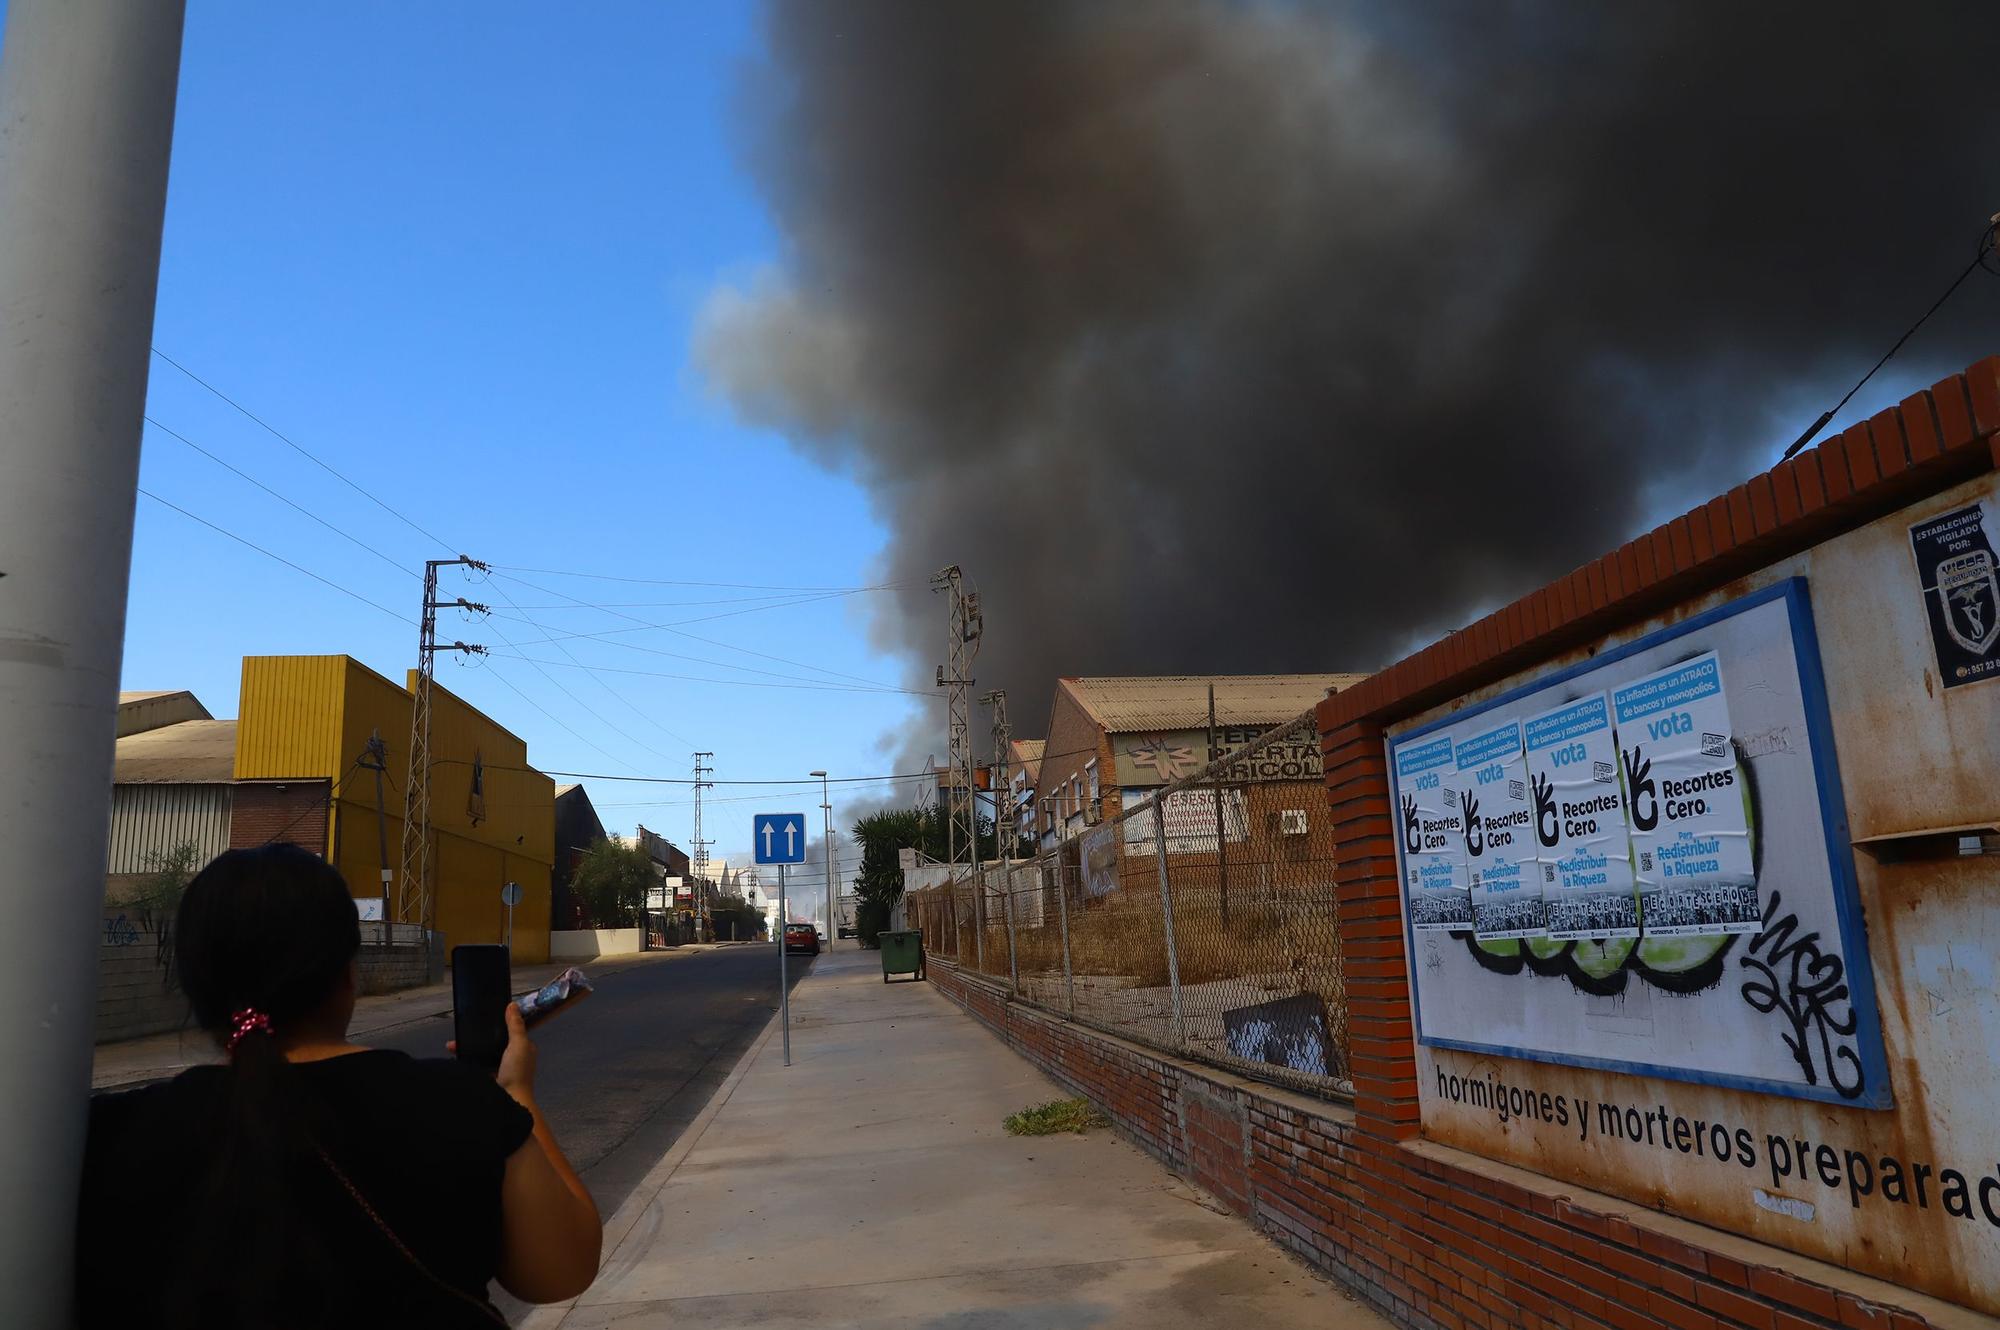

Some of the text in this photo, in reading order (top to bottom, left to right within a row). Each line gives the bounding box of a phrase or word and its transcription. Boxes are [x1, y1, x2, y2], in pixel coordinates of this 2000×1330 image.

[1936, 524, 1979, 544] VIGILADO
[1948, 539, 1971, 552] POR:
[1616, 663, 1714, 705] La inflación es un ATRACO
[1623, 681, 1715, 718] de bancos y monopolios.
[1526, 701, 1603, 735] La inflación es un ATRACO
[1647, 711, 1693, 741] vota
[1531, 716, 1605, 746] de bancos y monopolios.
[1551, 742, 1587, 768] vota
[1415, 772, 1440, 791] vota
[1476, 763, 1504, 785] vota
[1662, 769, 1734, 799] Recortes
[1562, 794, 1618, 819] Recortes
[1665, 799, 1711, 820] Cero.
[1423, 817, 1460, 833] Recortes
[1485, 810, 1529, 832] Recortes
[1565, 818, 1601, 838] Cero.
[1678, 831, 1693, 841] Para
[1575, 847, 1587, 855] Para
[1657, 836, 1720, 860] Redistribuir
[1482, 863, 1520, 880] Redistribuir
[1557, 853, 1607, 873] Redistribuir
[1663, 859, 1719, 877] la Riqueza
[1486, 880, 1520, 893] la Riqueza
[1562, 871, 1607, 888] la Riqueza
[1436, 1065, 1568, 1126] hormigones
[1575, 1100, 1588, 1141] y
[1599, 1101, 1755, 1168] morteros
